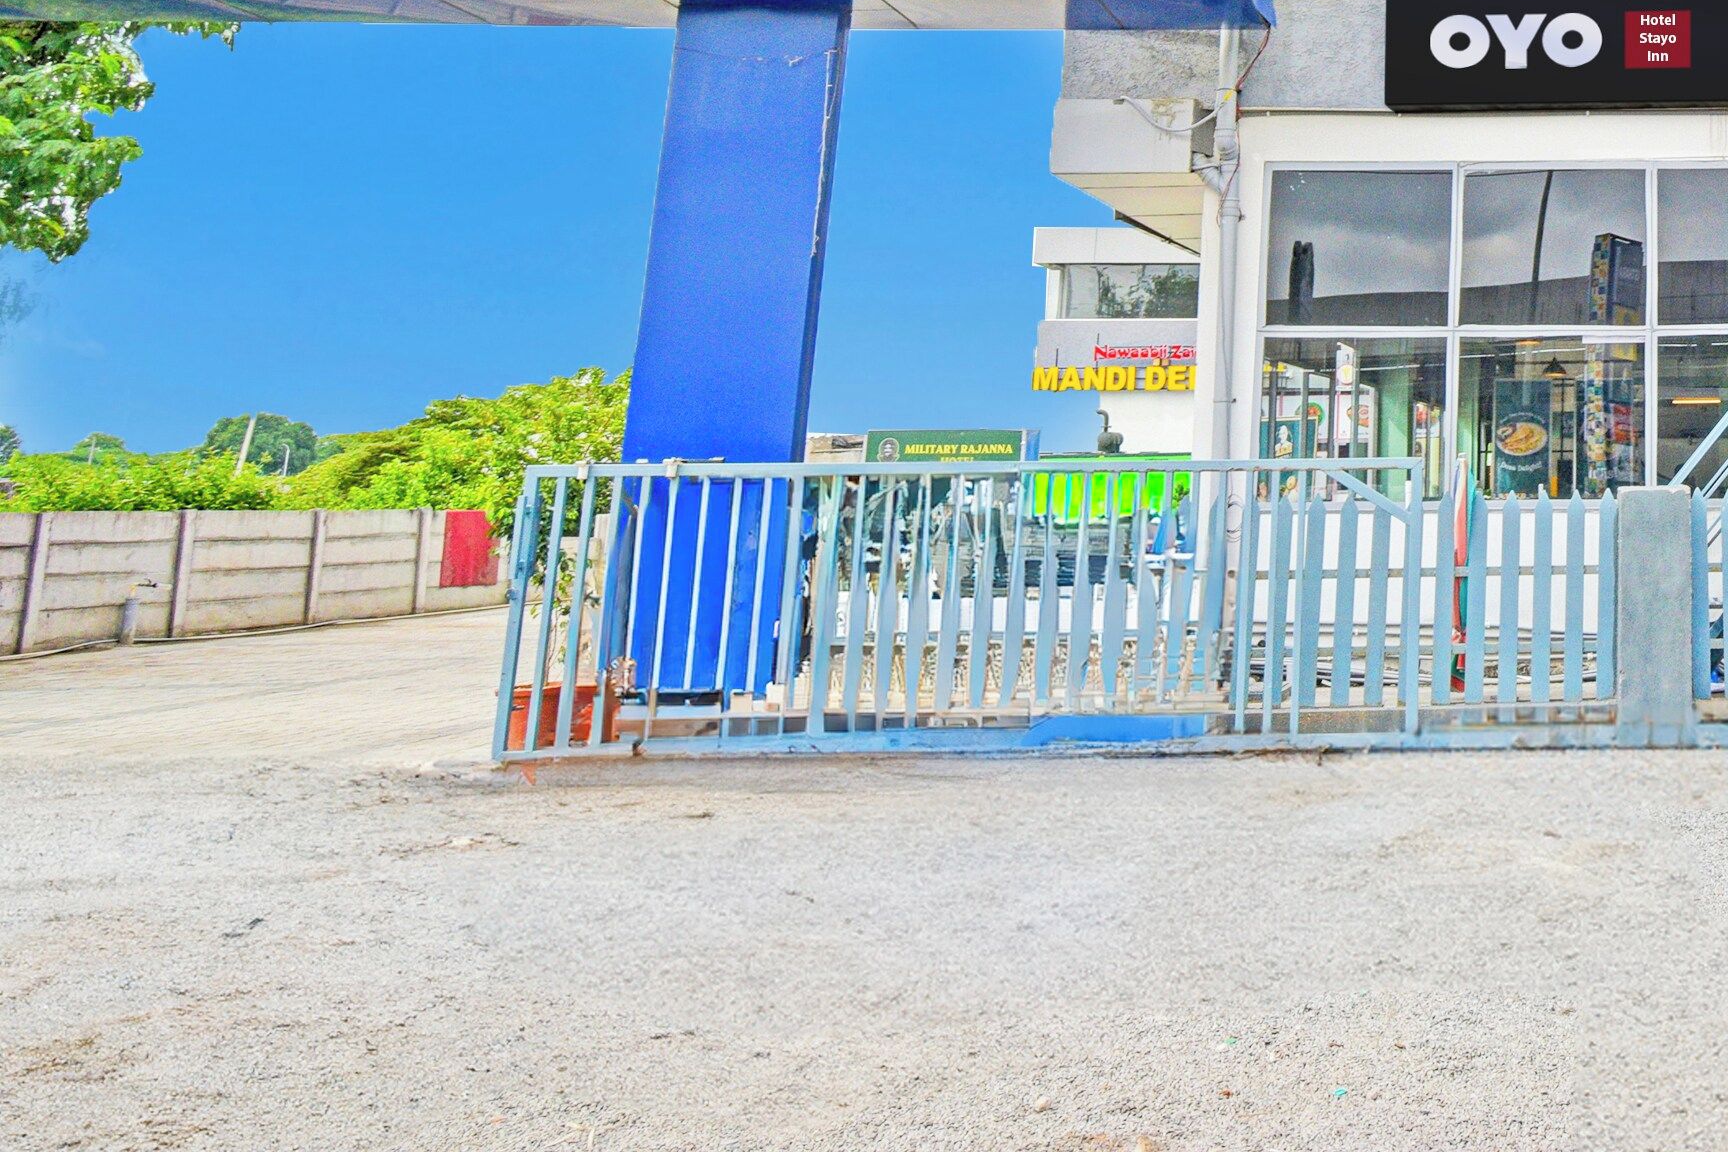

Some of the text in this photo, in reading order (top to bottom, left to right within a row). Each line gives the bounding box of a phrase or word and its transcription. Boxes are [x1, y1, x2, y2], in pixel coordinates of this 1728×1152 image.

[1639, 13, 1677, 27] Hotel
[1429, 12, 1604, 70] OYO
[1638, 32, 1678, 46] Stayo
[1646, 50, 1670, 63] Inn
[1032, 364, 1136, 392] MANDI
[904, 443, 1013, 455] MILITARY RAJANNA
